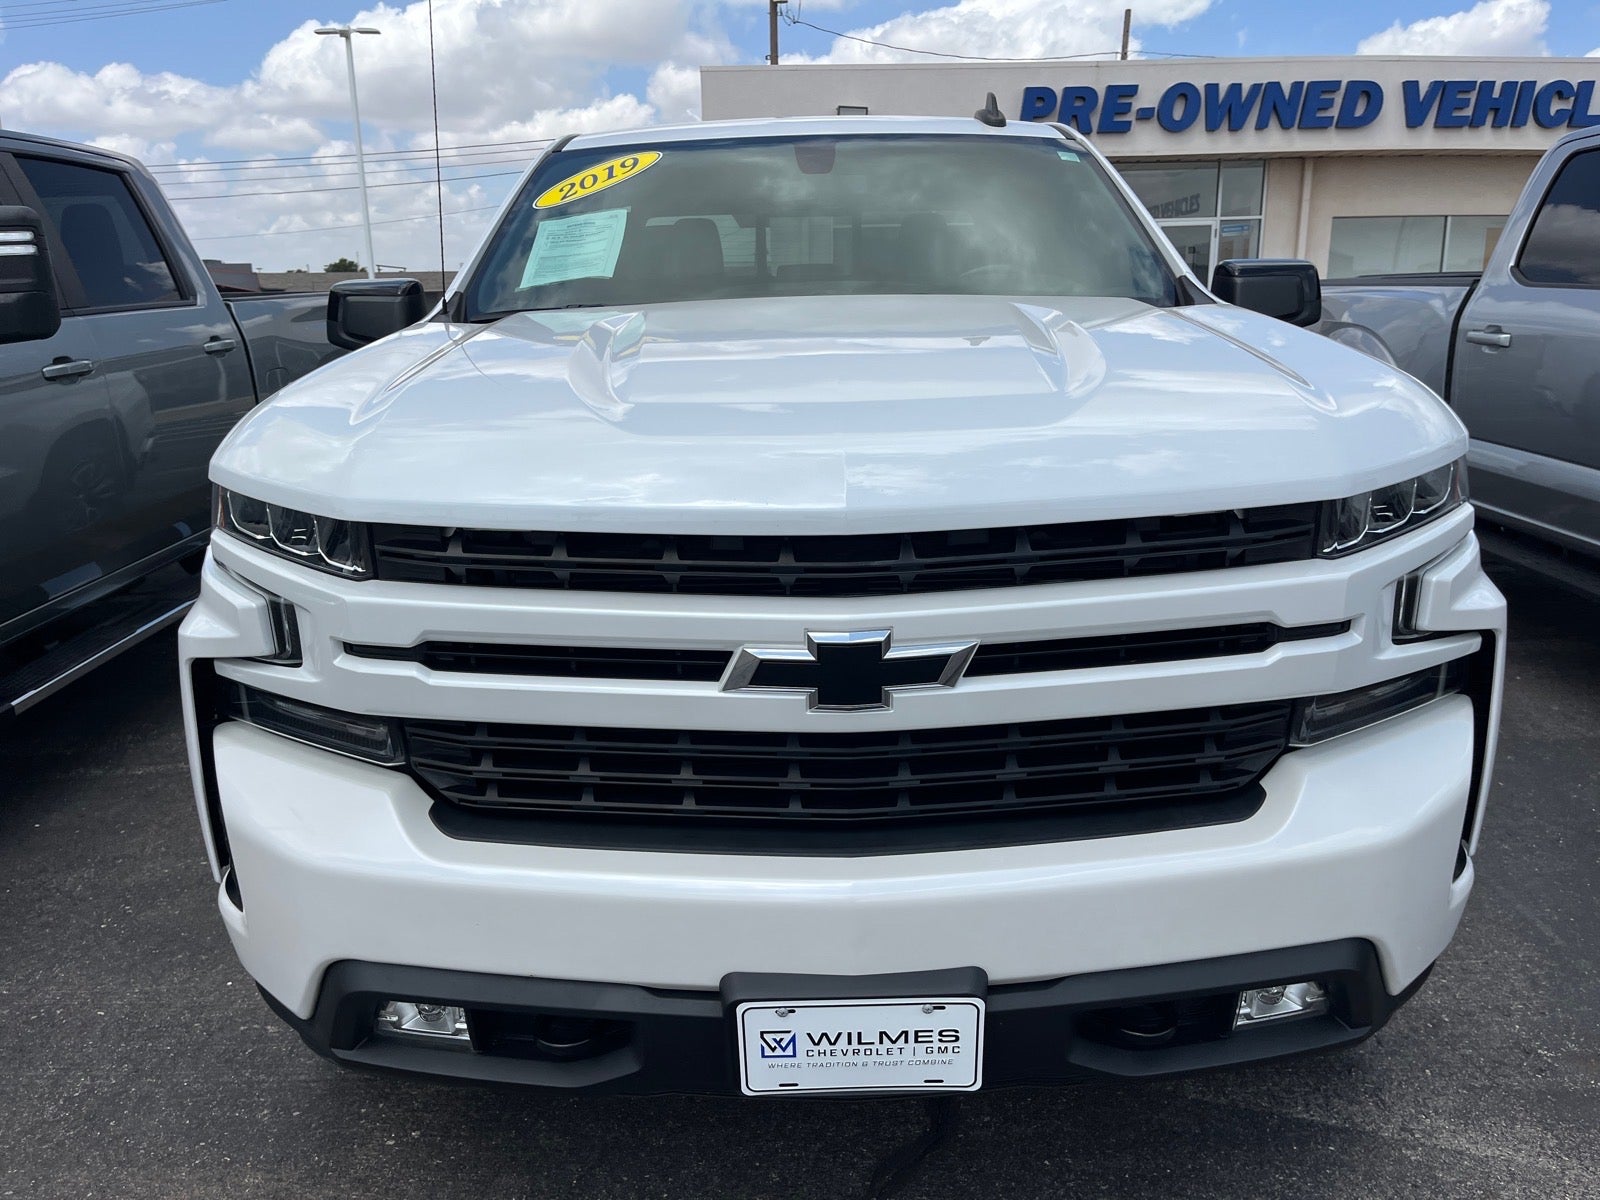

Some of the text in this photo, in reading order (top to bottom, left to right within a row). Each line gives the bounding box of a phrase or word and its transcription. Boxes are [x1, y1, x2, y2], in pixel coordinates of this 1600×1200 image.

[1020, 80, 1384, 135] PRE-OWNED
[558, 157, 640, 201] 2019
[806, 1028, 960, 1046] WILMES
[806, 1047, 905, 1057] CHEVROLET
[925, 1045, 960, 1054] GMC
[907, 1058, 954, 1066] COMBINE
